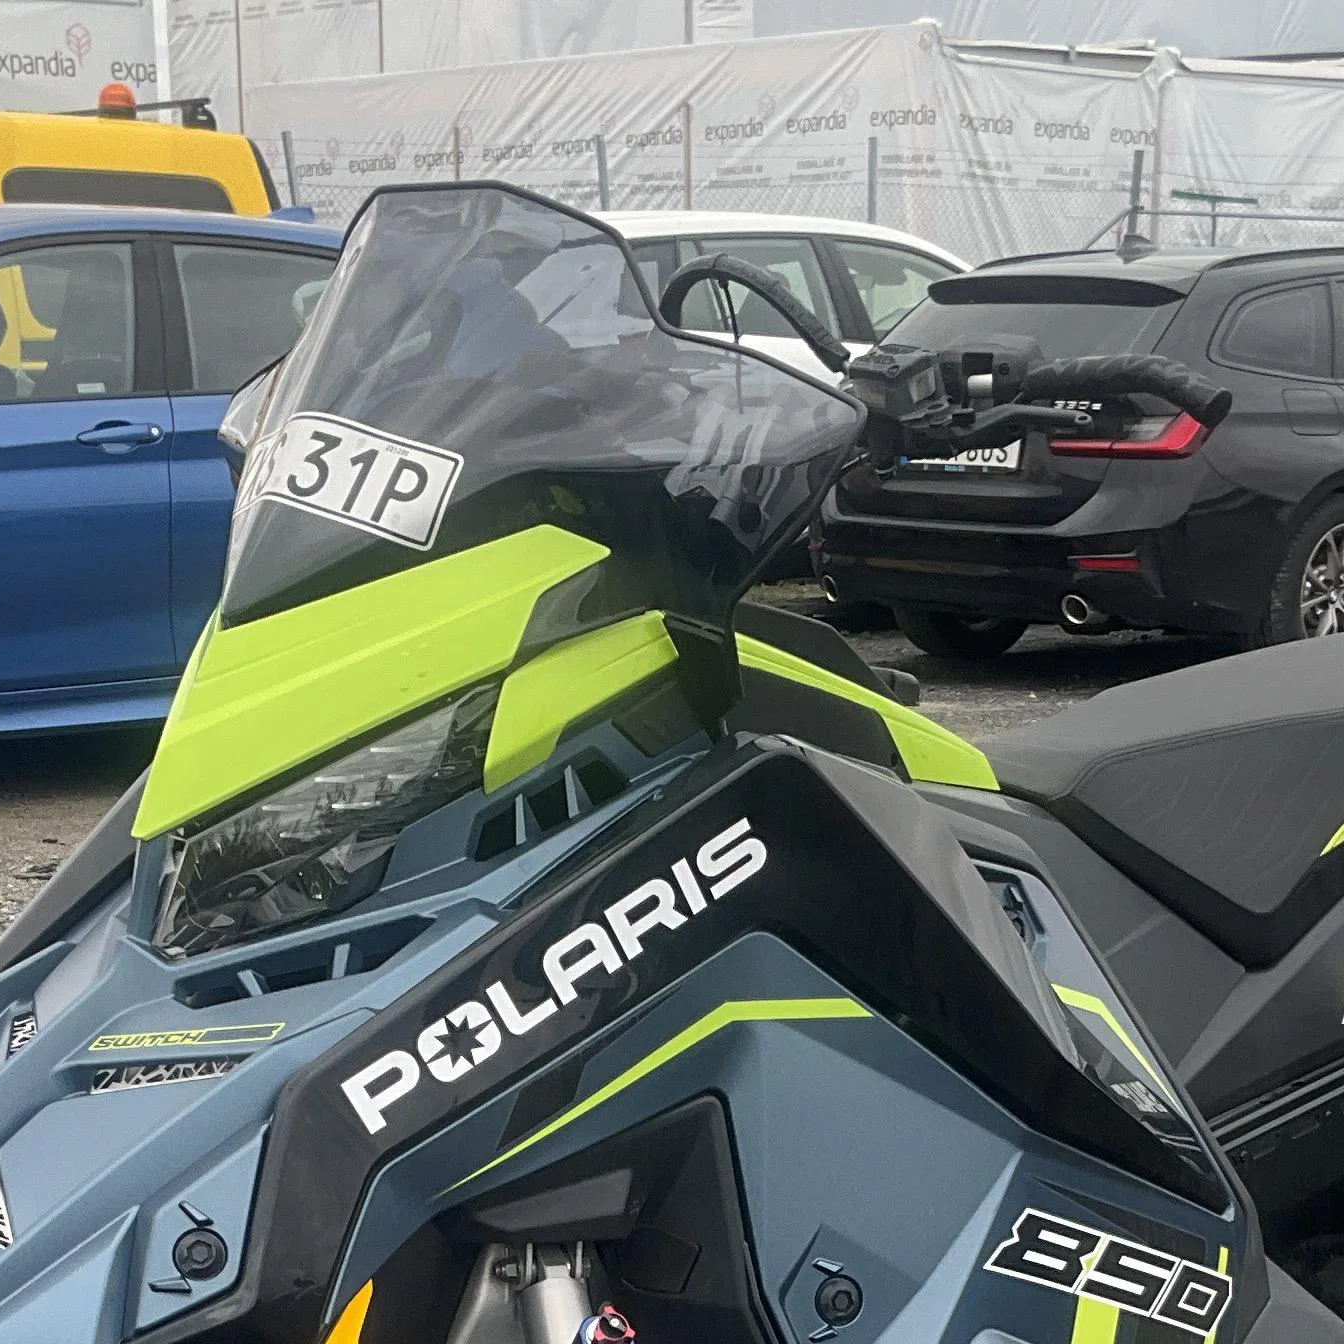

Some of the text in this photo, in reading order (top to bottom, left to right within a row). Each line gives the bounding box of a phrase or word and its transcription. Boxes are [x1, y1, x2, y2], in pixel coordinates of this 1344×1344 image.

[705, 117, 764, 145] expandia
[786, 110, 847, 136] expandia
[870, 104, 937, 131] expandia
[1034, 119, 1090, 142] expandia
[287, 430, 429, 524] 31P
[340, 816, 768, 1135] POLARIS
[93, 1031, 204, 1049] SWITCH
[982, 1207, 1233, 1338] 850
